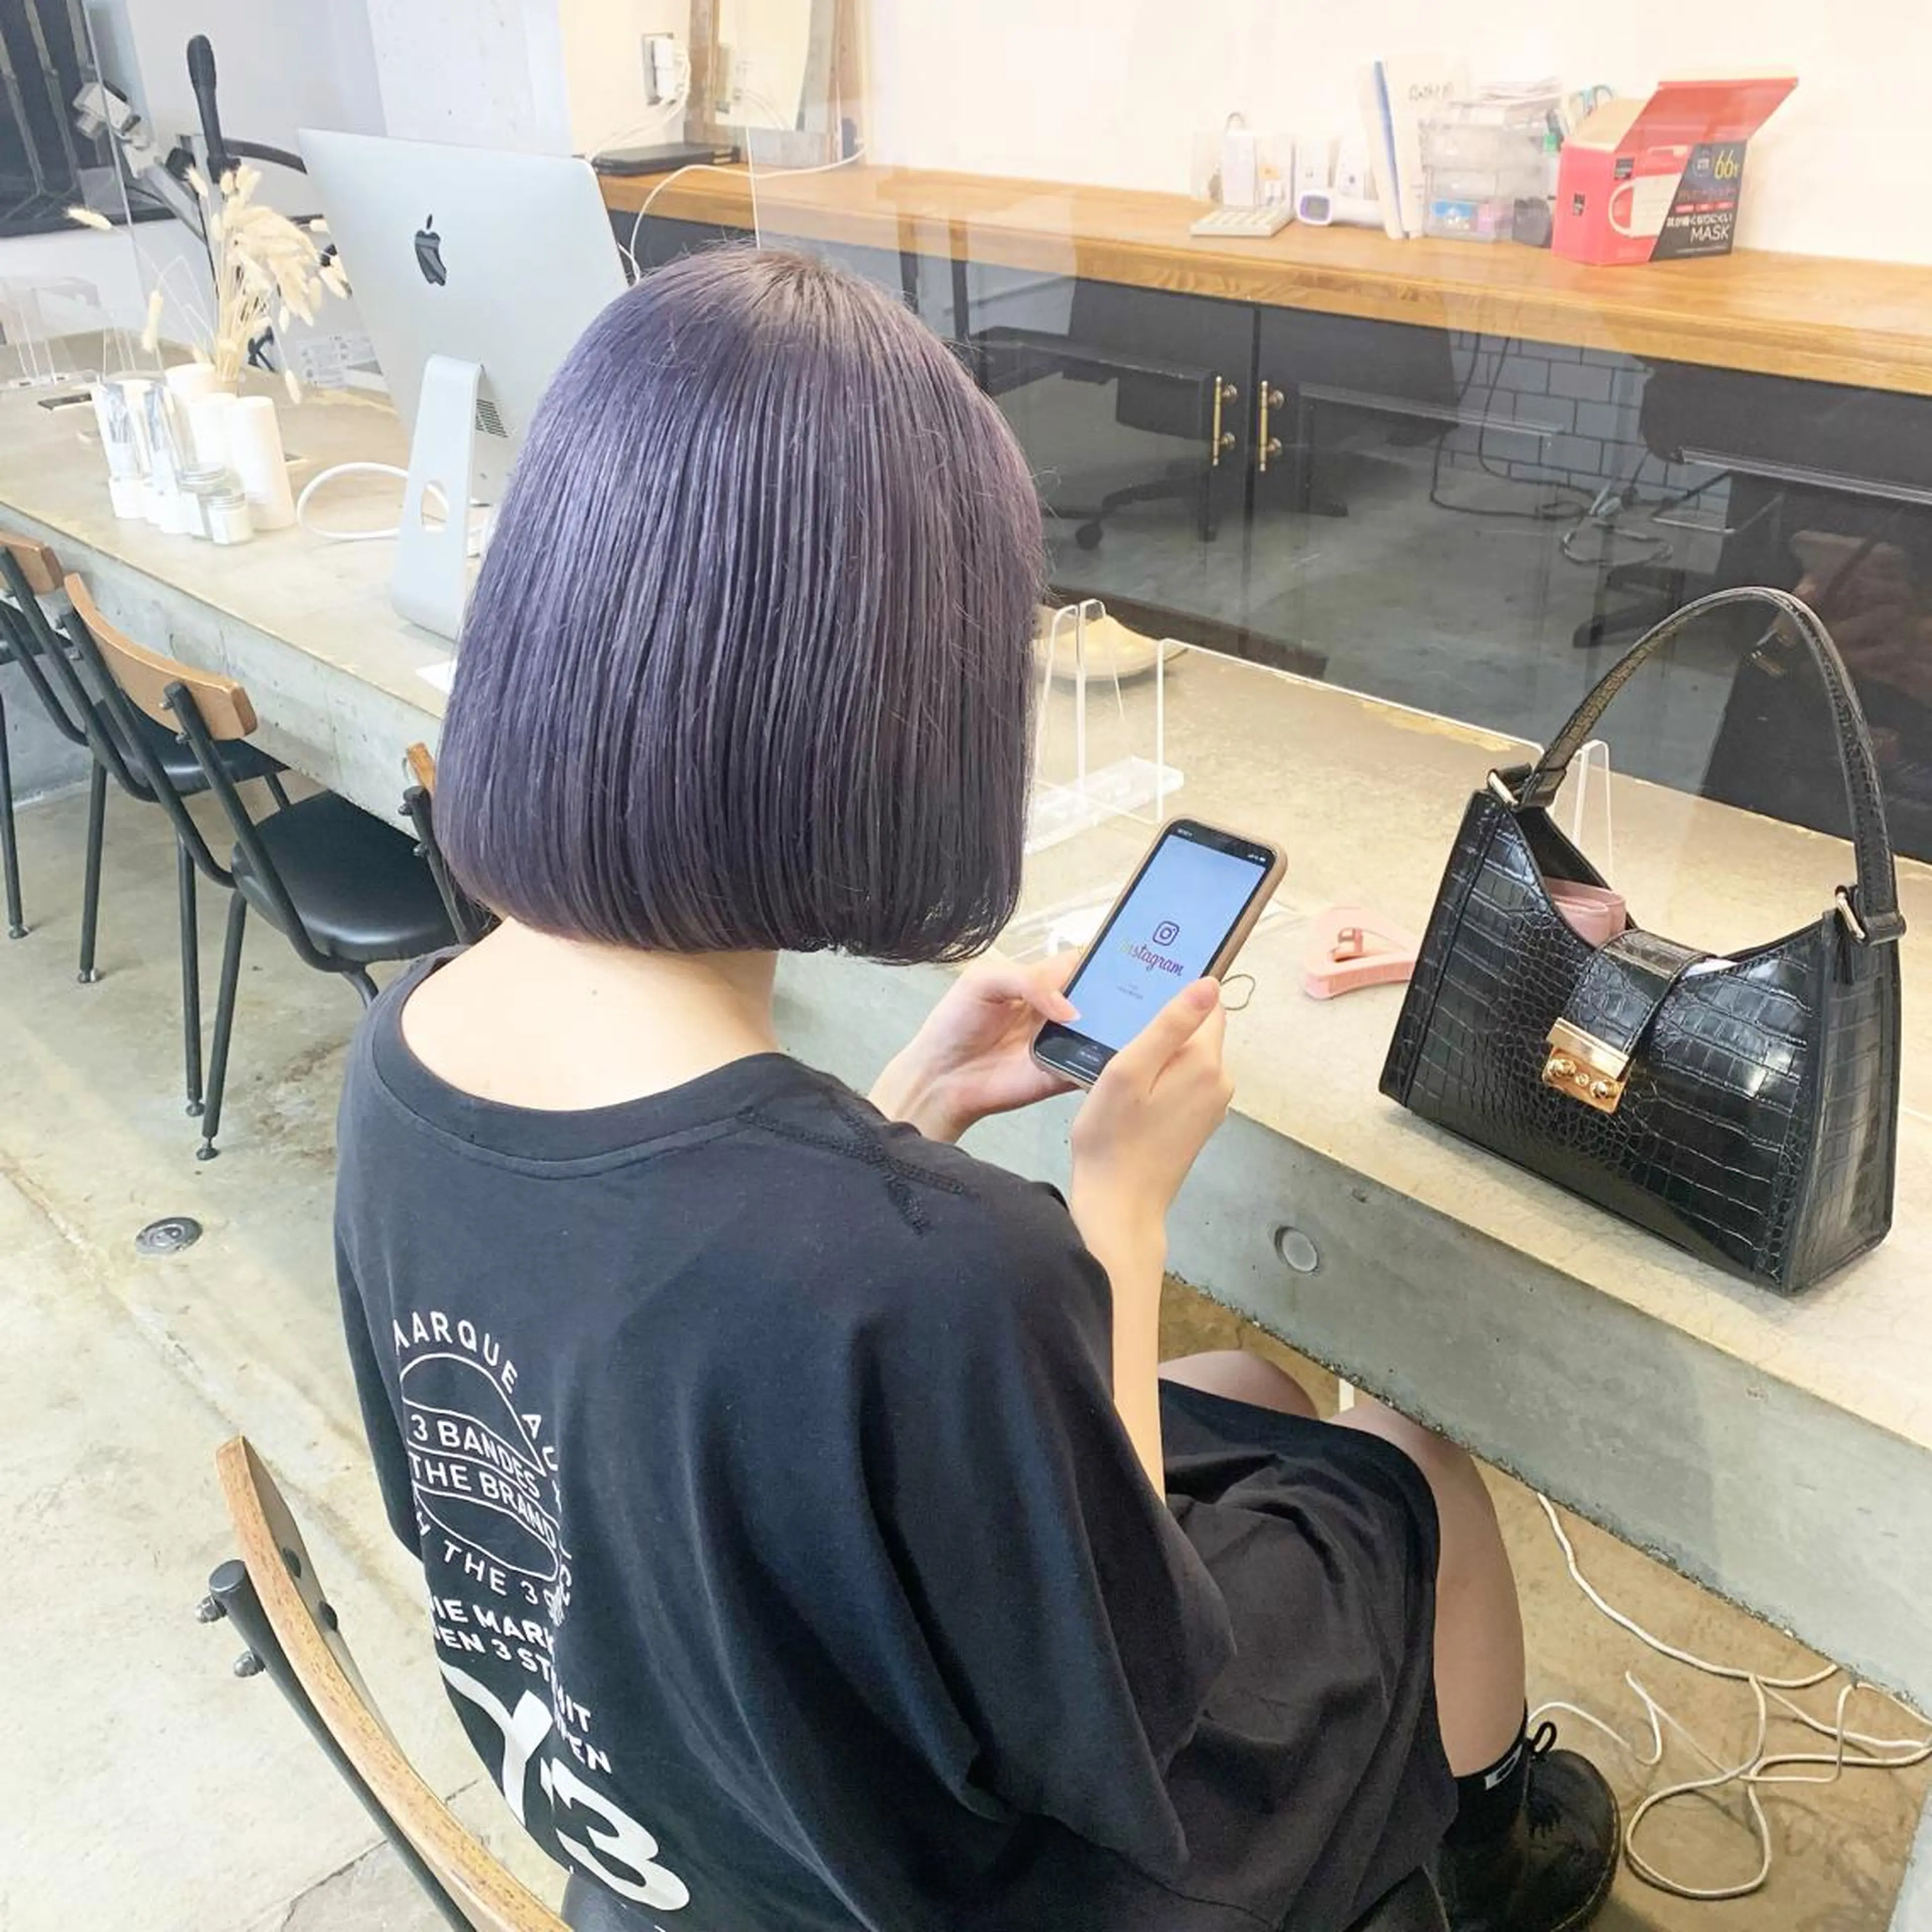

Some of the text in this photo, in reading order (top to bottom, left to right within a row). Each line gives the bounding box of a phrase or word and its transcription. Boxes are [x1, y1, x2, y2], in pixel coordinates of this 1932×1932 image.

[1691, 223, 1731, 244] MASK
[411, 1414, 540, 1499] 3 BANDES
[408, 1451, 472, 1492] THE
[479, 1471, 556, 1549] BRAND
[443, 1539, 507, 1596] THE
[520, 1580, 539, 1605] 3
[431, 1613, 486, 1654] EN
[491, 1639, 512, 1661] 3
